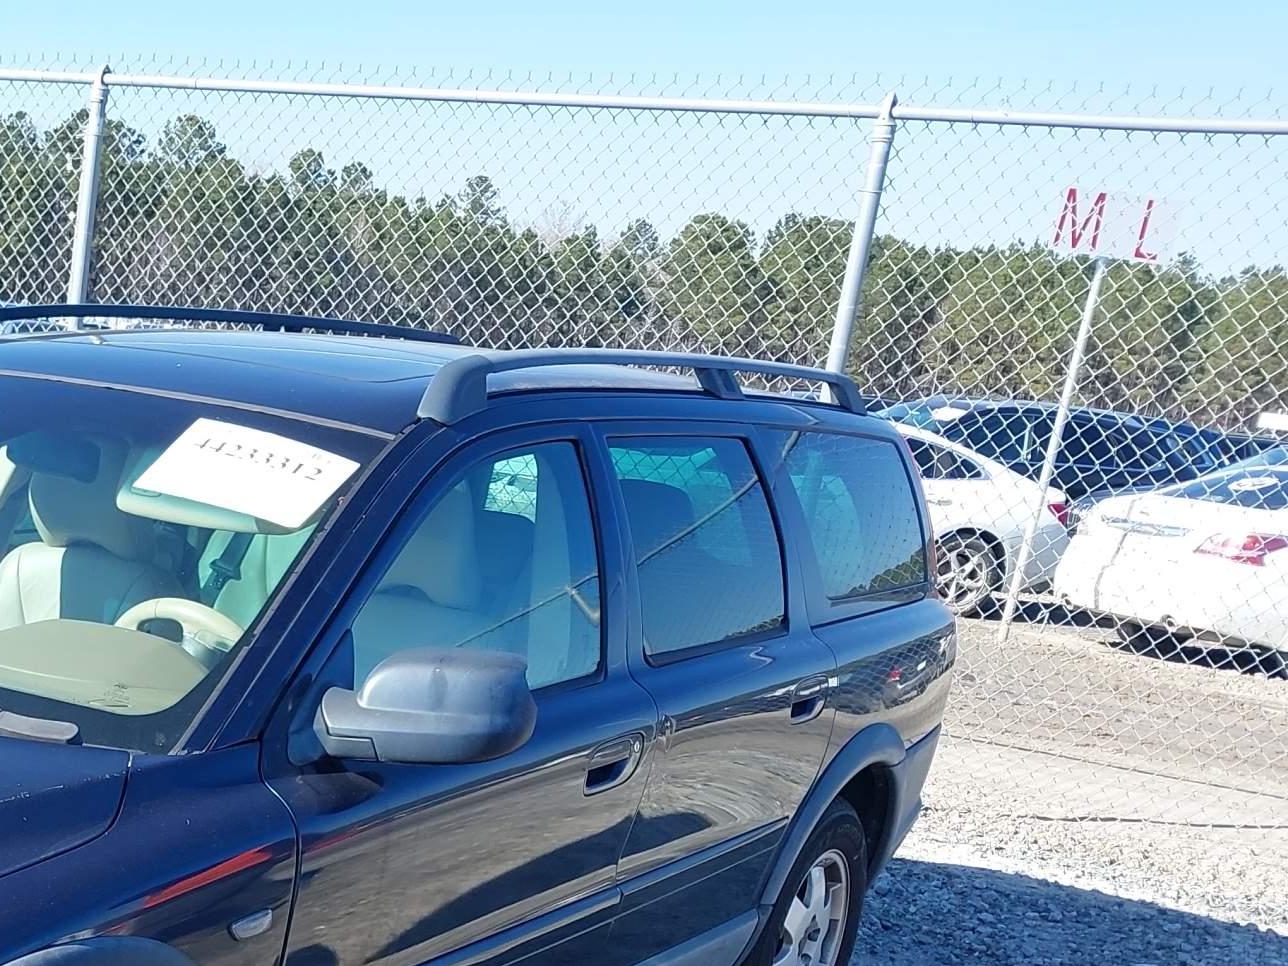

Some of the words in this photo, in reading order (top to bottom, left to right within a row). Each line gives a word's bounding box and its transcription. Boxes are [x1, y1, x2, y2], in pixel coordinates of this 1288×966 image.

[1053, 187, 1107, 252] M
[1134, 199, 1158, 260] L
[193, 438, 323, 481] 44233312
